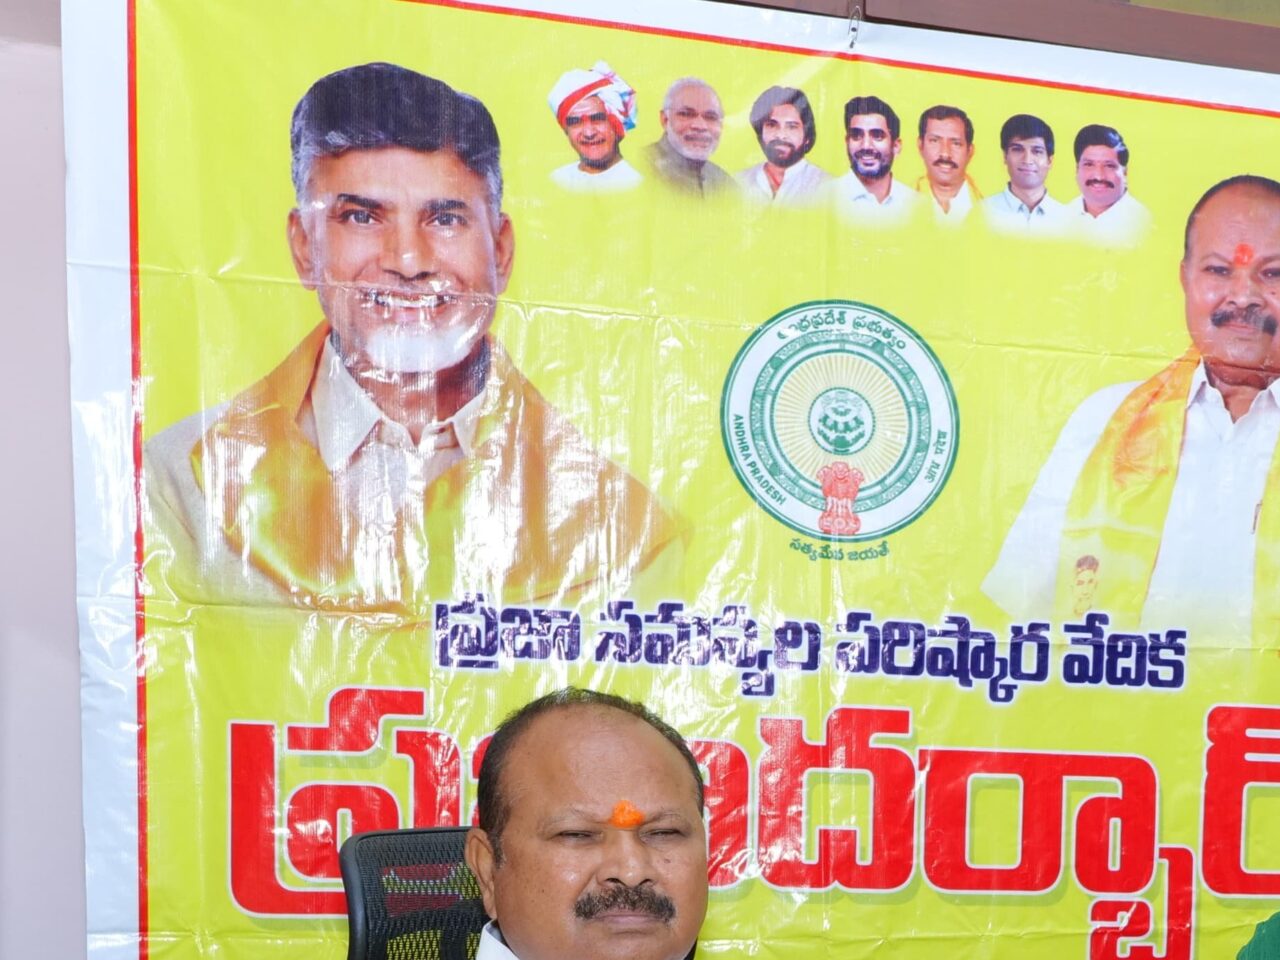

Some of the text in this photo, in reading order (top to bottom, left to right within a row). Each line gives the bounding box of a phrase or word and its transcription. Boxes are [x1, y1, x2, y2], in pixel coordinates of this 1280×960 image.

[733, 414, 787, 505] ANDHRA PRADESH
[435, 592, 581, 669] ప్రజా
[836, 611, 1050, 703] పరిష్కార
[1062, 612, 1187, 689] వేదిక
